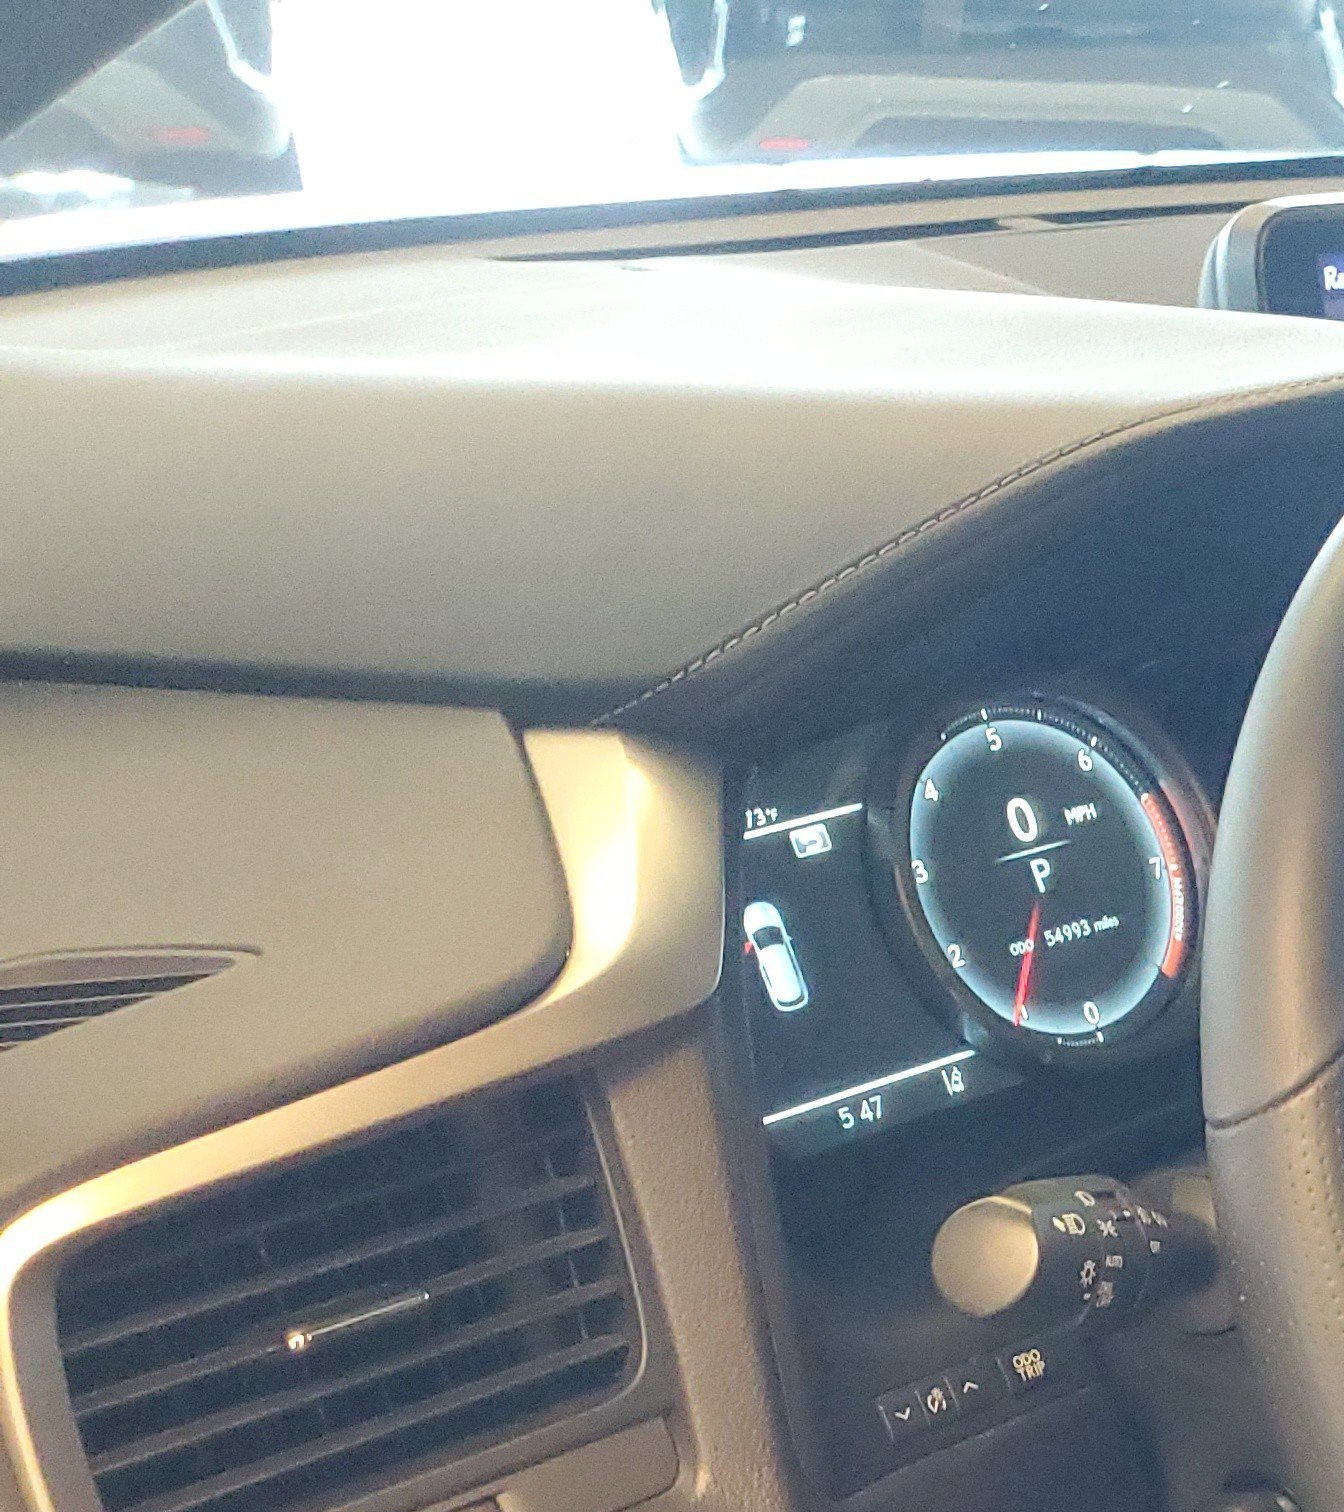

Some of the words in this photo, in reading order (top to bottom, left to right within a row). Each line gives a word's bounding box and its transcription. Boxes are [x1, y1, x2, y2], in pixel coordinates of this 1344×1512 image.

[985, 727, 1002, 751] 5
[1077, 748, 1094, 772] 6
[924, 778, 939, 802] 4
[1006, 797, 1038, 842] 0
[1064, 801, 1097, 826] MPH
[911, 859, 929, 884] 3
[1030, 858, 1051, 893] P
[1009, 938, 1035, 957] ODO
[1043, 918, 1091, 948] 54993
[1093, 914, 1120, 933] miles
[947, 944, 966, 969] 2
[1012, 1348, 1041, 1369] ODO
[1016, 1360, 1046, 1382] TRIP
